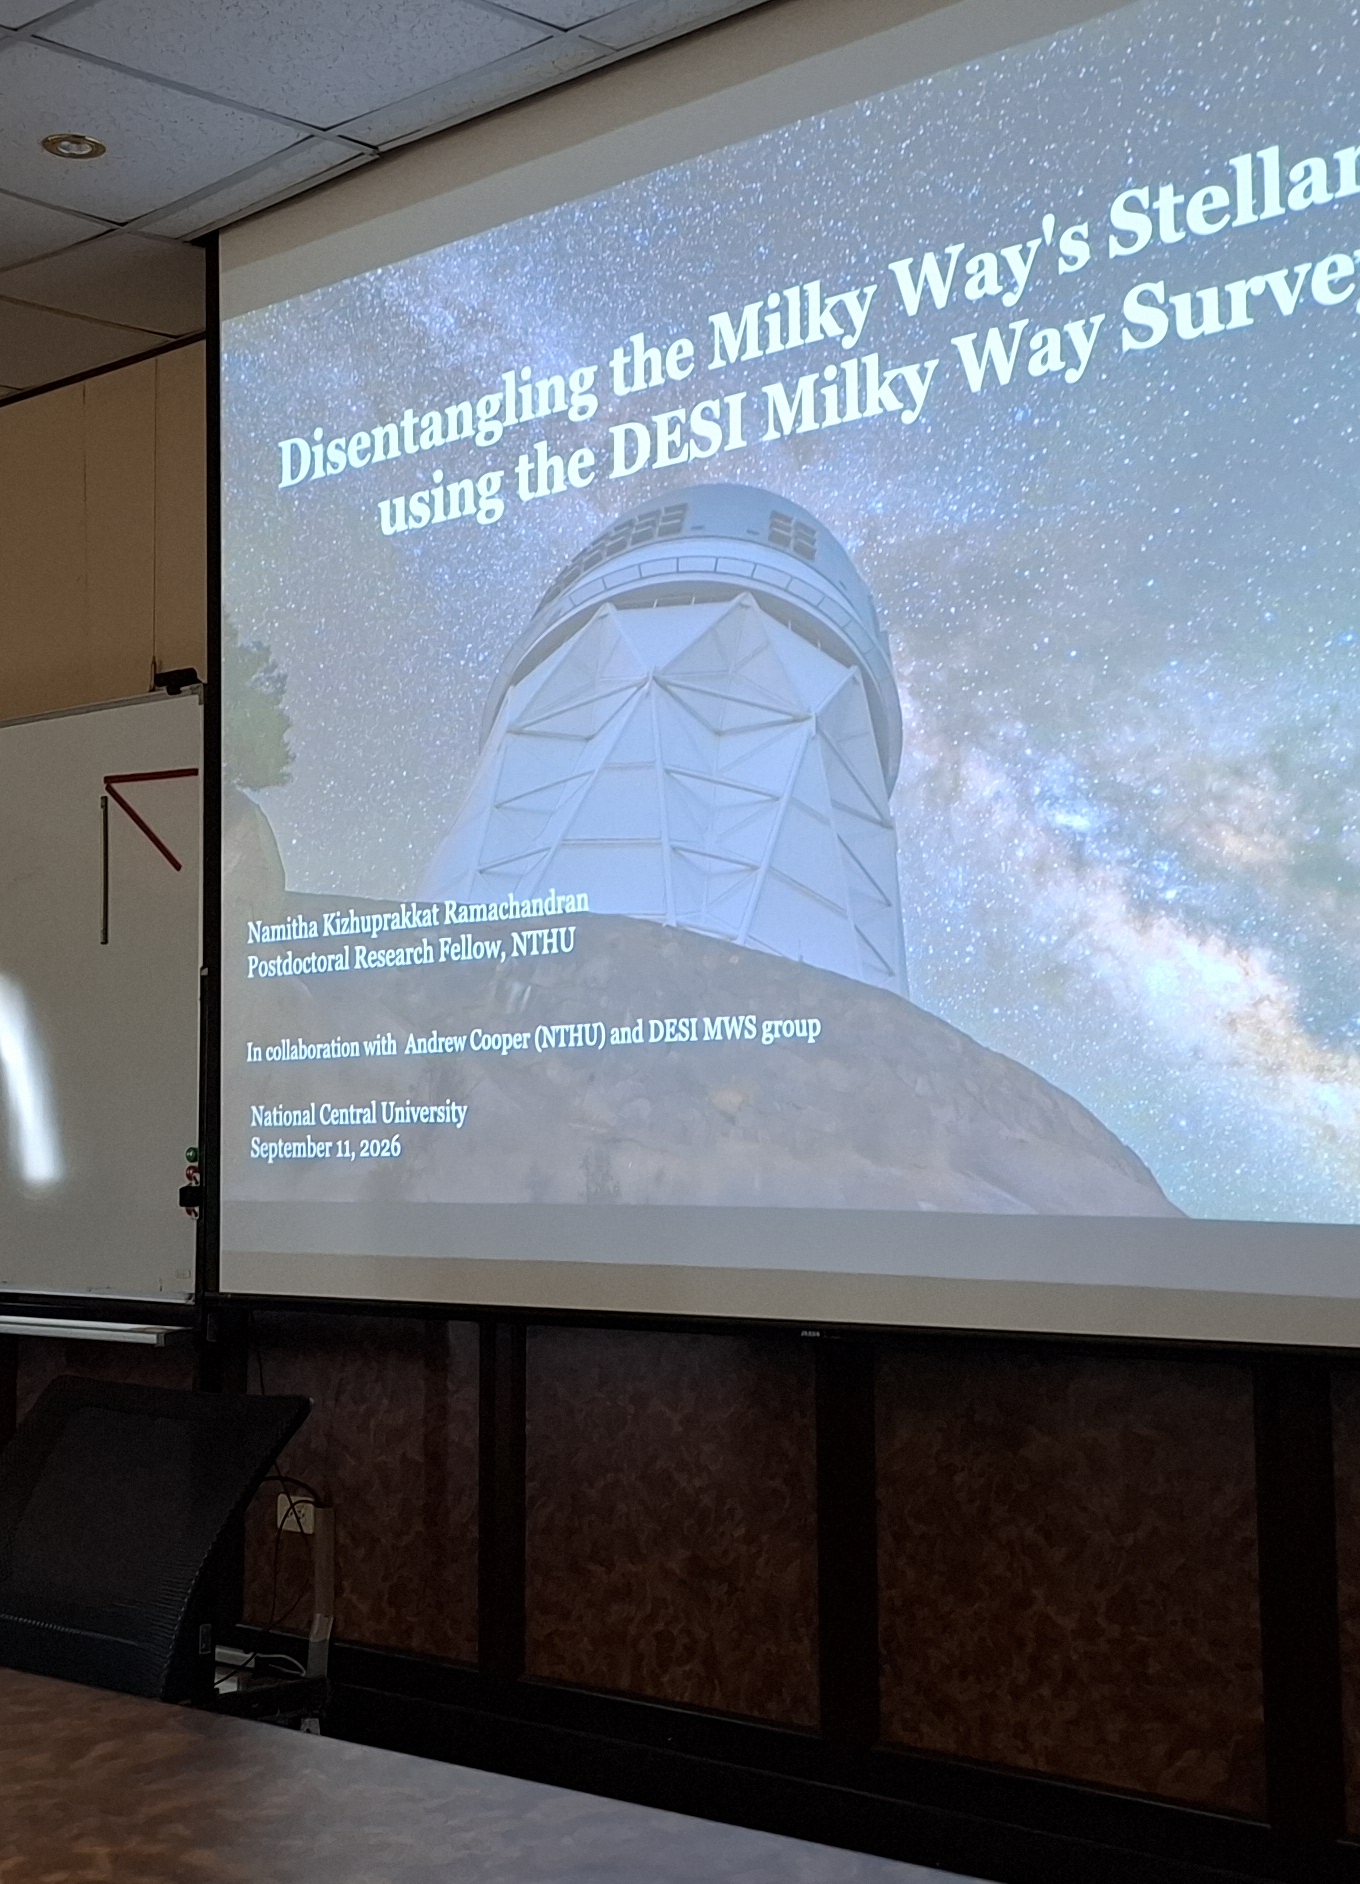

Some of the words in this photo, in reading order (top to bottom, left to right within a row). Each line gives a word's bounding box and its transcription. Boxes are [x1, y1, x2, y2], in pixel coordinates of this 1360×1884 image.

[278, 366, 598, 489] Disentangling
[610, 333, 694, 398] the
[708, 279, 878, 369] Milky
[889, 213, 1091, 316] Way's
[379, 469, 505, 536] using
[516, 438, 595, 502] the
[609, 400, 745, 480] DESI
[761, 351, 939, 442] Milky
[951, 311, 1106, 394] Way
[246, 916, 318, 944] Namitha
[322, 902, 440, 939] Kizhuprakkat
[444, 889, 588, 924] Ramachandran
[247, 946, 348, 978] Postdoctoral
[354, 938, 434, 970] Research
[438, 933, 506, 965] Fellow,
[511, 926, 576, 957] NTHU
[246, 1041, 262, 1062] In
[266, 1036, 360, 1062] collaboration
[364, 1032, 397, 1056] with
[404, 1030, 466, 1056] Andrew
[470, 1028, 530, 1055] Cooper
[534, 1021, 606, 1052] (NTHU)
[610, 1019, 644, 1044] and
[648, 1018, 698, 1043] DESI
[702, 1014, 757, 1041] MWS
[762, 1016, 821, 1044] group
[250, 1104, 315, 1128] National
[319, 1101, 377, 1126] Central
[381, 1098, 468, 1128] University
[250, 1134, 332, 1164] September
[336, 1138, 356, 1162] 11,
[360, 1135, 401, 1158] 2026
